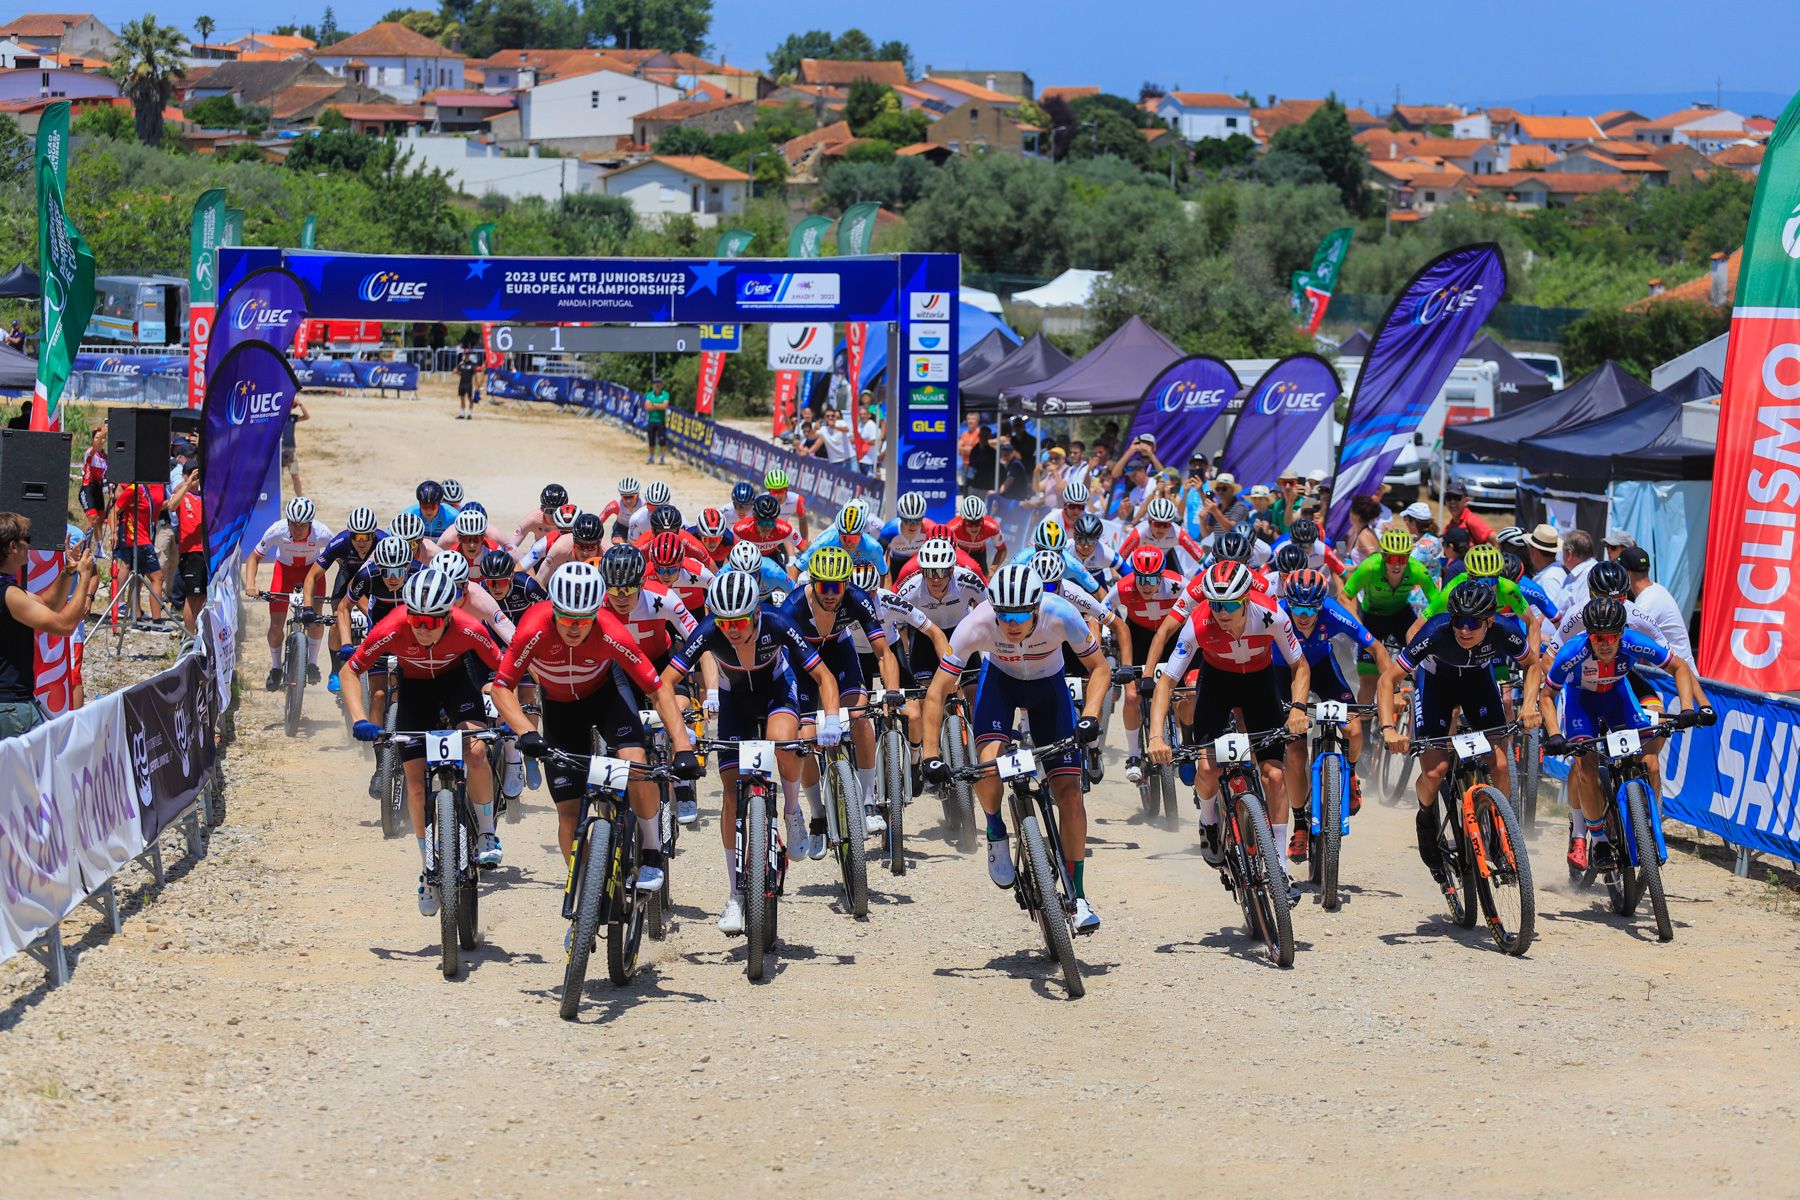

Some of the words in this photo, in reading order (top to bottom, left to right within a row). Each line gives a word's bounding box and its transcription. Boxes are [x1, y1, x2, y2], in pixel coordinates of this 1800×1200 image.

[505, 272, 536, 282] 2023
[540, 272, 566, 282] UEC
[569, 272, 597, 283] MTB
[599, 272, 685, 284] JUNIORS/U23
[389, 282, 427, 296] UEC
[506, 284, 575, 294] EUROPEAN
[579, 284, 685, 295] CHAMPIONSHIPS
[592, 300, 633, 308] PORTUGAL
[257, 309, 292, 324] UEC
[676, 340, 686, 351] 0
[778, 353, 823, 366] vittoria
[382, 375, 406, 385] UEC
[250, 391, 283, 414] UEC
[1186, 389, 1225, 405] UEC
[1286, 393, 1325, 408] UEC
[925, 457, 948, 467] UEC
[1730, 342, 1800, 669] CICLISMO
[957, 573, 986, 592] KTM
[1063, 589, 1092, 610] Cofidis
[861, 599, 878, 622] SKF
[1562, 608, 1584, 633] Cofid
[685, 634, 706, 658] SKF
[786, 627, 808, 651] SKF
[1410, 637, 1432, 656] SKF
[1323, 703, 1340, 720] 12
[1414, 688, 1425, 727] FRANCE
[439, 737, 449, 759] 6
[1227, 740, 1237, 761] 5
[1618, 736, 1629, 753] 8
[752, 752, 761, 770] 3
[1011, 756, 1021, 769] 4
[602, 764, 613, 786] 1
[1709, 709, 1800, 842] SHI
